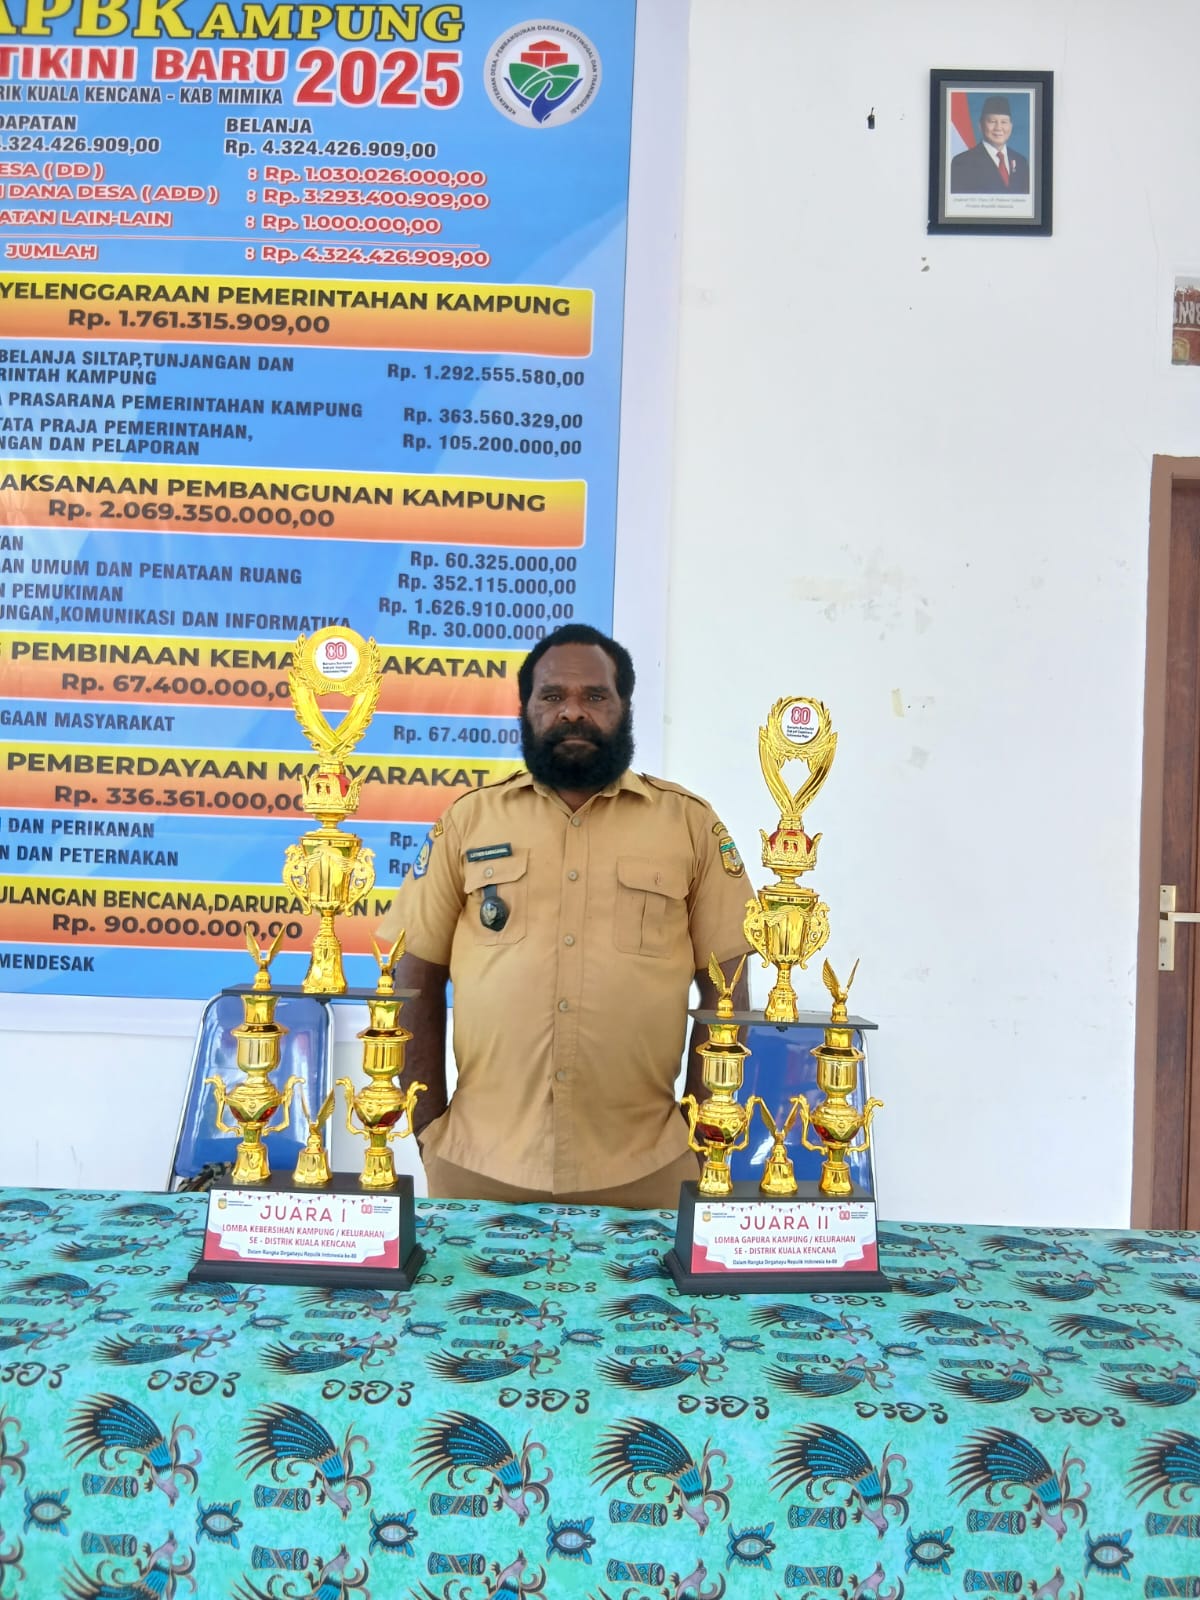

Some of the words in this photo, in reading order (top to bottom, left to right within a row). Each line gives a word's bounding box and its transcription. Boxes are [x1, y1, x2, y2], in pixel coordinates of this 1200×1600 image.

[0, 46, 137, 81] TIKINI
[153, 47, 288, 83] BARU
[295, 48, 462, 107] 2025
[27, 86, 79, 102] KUALA
[85, 87, 161, 102] KENCANA
[180, 88, 212, 103] KAB
[218, 89, 283, 104] MIMIKA
[226, 119, 312, 133] BELANJA
[0, 137, 160, 154] .324.426.909,00
[225, 140, 255, 156] Rp.
[262, 141, 437, 159] 4.324.426.909,00
[264, 166, 300, 184] Rp.
[305, 167, 487, 188] 1.030.026.000,00
[9, 186, 72, 200] DANA
[78, 186, 137, 201] DESA
[263, 189, 300, 207] Rp.
[304, 189, 490, 209] 3.293.400.909,00
[61, 211, 173, 227] LAIN-LAIN
[263, 214, 300, 232] Rp.
[303, 215, 441, 234] 1.000.000,00
[6, 244, 97, 260] JUMLAH
[262, 246, 300, 264] Rp.
[303, 247, 490, 268] 4.324.426.909,00
[0, 282, 209, 303] YELENGGARAAN
[218, 286, 428, 310] PEMERINTAHAN
[436, 293, 570, 316] KAMPUNG
[68, 309, 111, 330] Rp.
[119, 310, 330, 335] 1.761.315.909,00
[0, 350, 75, 365] BELANJA
[258, 356, 294, 371] DAN
[387, 364, 416, 382] Rp.
[424, 365, 585, 388] 1.292.555.580,00
[66, 370, 157, 385] KAMPUNG
[9, 392, 115, 408] PRASARANA
[122, 395, 264, 414] PEMERINTAHAN
[271, 400, 363, 418] KAMPUNG
[403, 407, 432, 425] Rp.
[439, 408, 583, 432] 363.560.329,00
[40, 419, 97, 434] PRAJA
[104, 420, 253, 441] PEMERINTAHAN,
[402, 434, 432, 452] Rp.
[439, 435, 582, 457] 105.200.000,00
[49, 437, 85, 452] DAN
[92, 439, 200, 456] PELAPORAN
[0, 474, 158, 495] AKSANAAN
[167, 479, 393, 505] PEMBANGUNAN
[403, 488, 546, 512] KAMPUNG
[48, 499, 92, 520] Rp.
[100, 501, 335, 529] 2.069.350.000,00
[0, 536, 24, 551] AN
[410, 551, 439, 569] Rp.
[445, 553, 577, 574] 60.325.000,00
[31, 560, 89, 576] UMUM
[96, 561, 132, 577] DAN
[139, 563, 233, 582] PENATAAN
[240, 567, 302, 584] RUANG
[397, 573, 427, 592] Rp.
[433, 574, 576, 597] 352.115.000,00
[12, 583, 124, 602] PEMUKIMAN
[379, 597, 408, 616] Rp.
[414, 598, 574, 622] 1.626.910.000,00
[182, 612, 218, 628] DAN
[226, 613, 351, 632] INFORMATIKA
[408, 621, 437, 639] Rp.
[443, 622, 562, 641] 30.000.000
[11, 641, 200, 667] PEMBINAAN
[62, 673, 104, 694] Rp.
[113, 675, 291, 701] 67.400.000,0
[0, 710, 47, 727] GAAN
[54, 712, 175, 731] MASYARAKAT
[393, 725, 422, 744] Rp.
[428, 726, 520, 746] 67.400.00
[7, 752, 267, 780] PEMBERDAYAAN
[278, 762, 490, 787] MYARAKAT
[54, 785, 98, 807] Rp.
[9, 818, 44, 834] DAN
[51, 820, 155, 838] PERIKANAN
[390, 831, 418, 848] Rp.
[17, 845, 52, 861] DAN
[60, 847, 179, 866] PETERNAKAN
[389, 858, 412, 878] Rp
[103, 889, 306, 914] BENCANA,DARURA
[52, 913, 96, 935] Rp.
[104, 915, 303, 941] 90.000.000,00
[0, 954, 95, 972] MENDESAK
[260, 1205, 332, 1222] JUARA
[342, 1208, 346, 1222] I
[740, 1216, 809, 1230] JUARA
[818, 1217, 829, 1230] II
[222, 1224, 248, 1233] LOMBA
[250, 1226, 295, 1235] KEBERSIHAN
[297, 1228, 335, 1237] KAMPUNG
[341, 1230, 385, 1239] KELURAHAN
[249, 1236, 258, 1245] SE
[265, 1238, 293, 1246] DISTRIK
[295, 1239, 319, 1247] KUALA
[321, 1240, 356, 1249] KENCANA
[714, 1236, 739, 1244] LOMBA
[741, 1236, 771, 1245] GAPURA
[772, 1236, 808, 1244] KAMPUNG
[734, 1247, 743, 1255] SE
[749, 1247, 776, 1255] DISTRIK
